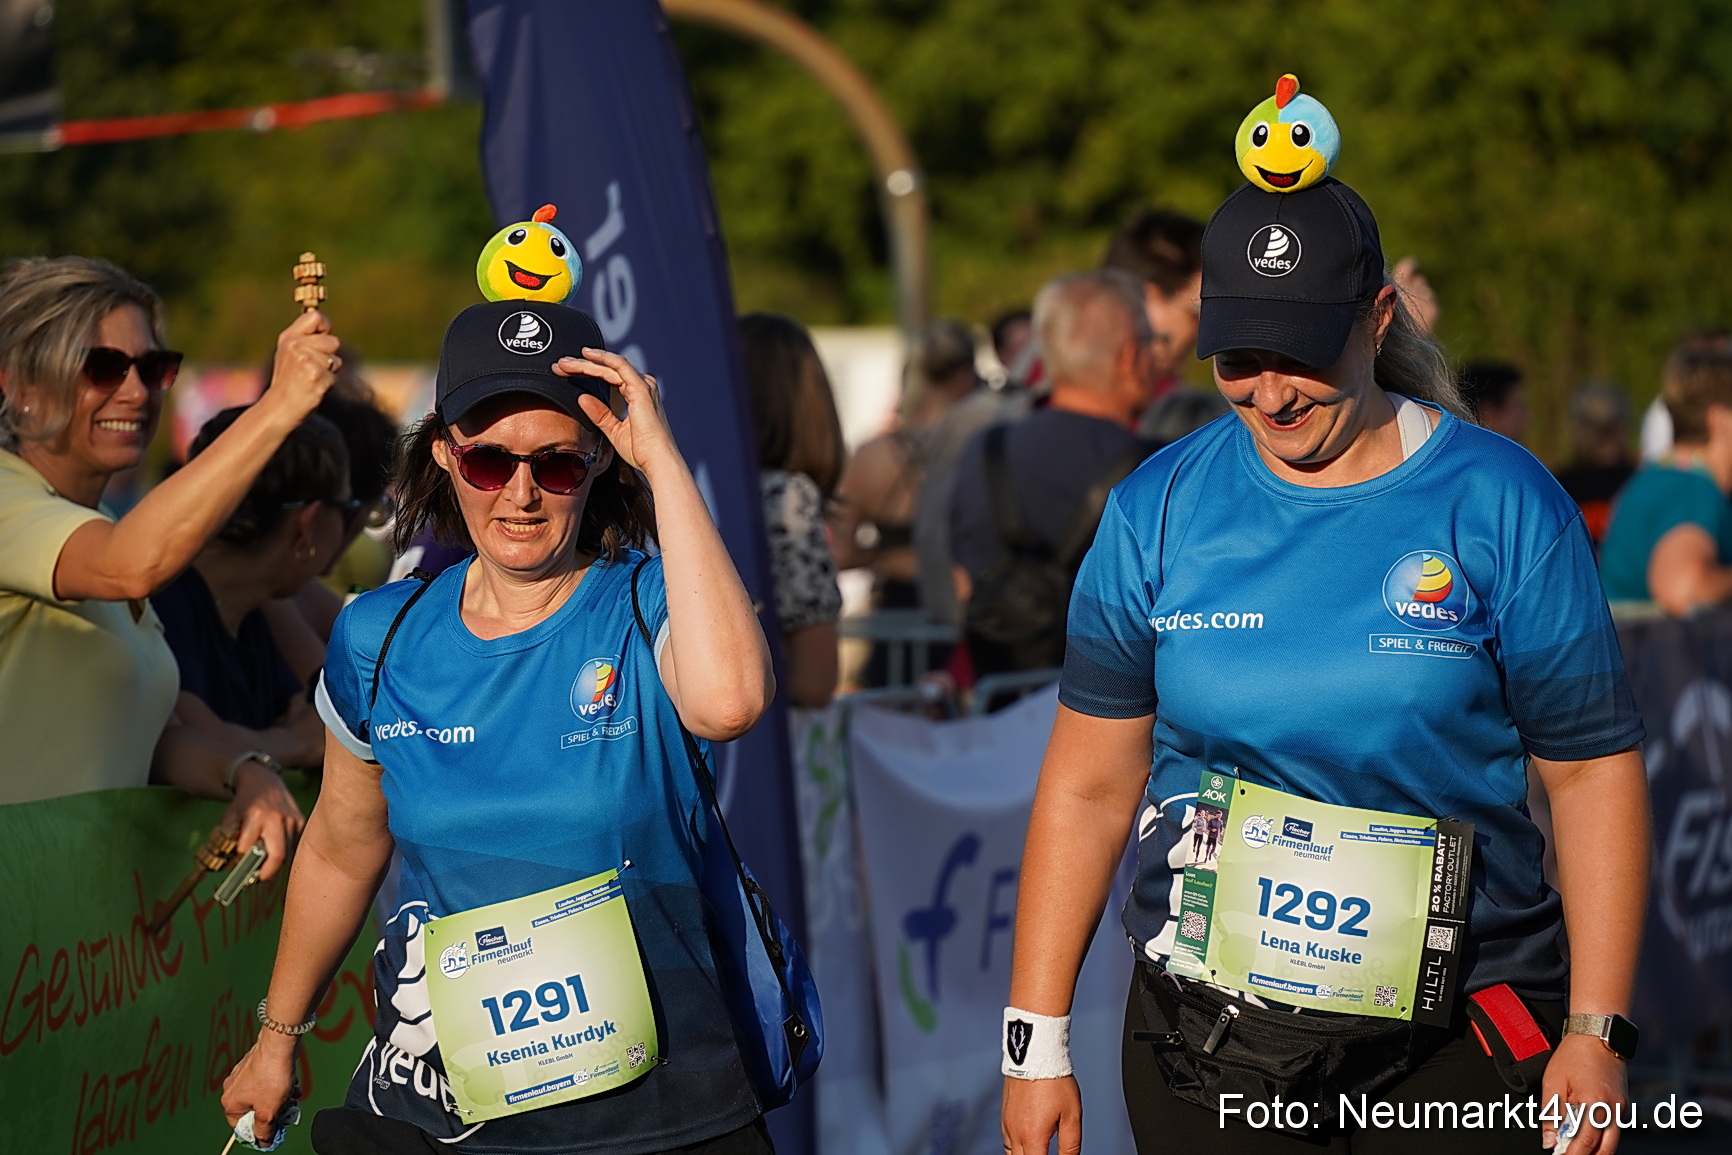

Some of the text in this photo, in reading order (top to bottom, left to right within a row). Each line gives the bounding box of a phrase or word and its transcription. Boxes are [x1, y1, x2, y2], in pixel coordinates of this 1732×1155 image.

[1254, 256, 1291, 270] vedes
[506, 338, 544, 350] vedes
[1395, 601, 1458, 622] vedes
[1379, 638, 1471, 653] SPIEL & FREIZEIT
[374, 717, 475, 744] vedes.com
[567, 720, 631, 744] SPIEL & FREIZEIT
[1202, 789, 1227, 803] AOK
[1272, 835, 1334, 855] Firmenlauf
[1293, 850, 1331, 862] neumarkt
[1185, 871, 1196, 879] Lust
[1431, 833, 1446, 912] 20 % RABATT
[1443, 835, 1457, 913] FACTORY OUTLET
[1257, 876, 1372, 938] 1292
[471, 937, 532, 965] Firmenlauf
[497, 948, 534, 965] neumarkt
[1260, 930, 1362, 966] Lena Kuske
[1290, 958, 1326, 971] KLEBL GmbH
[1251, 975, 1313, 994] firmenlauf.bayern
[1421, 956, 1442, 1011] HILTL
[482, 974, 590, 1036] 1291
[486, 1020, 617, 1067] Ksenia Kurdyk
[538, 1053, 574, 1066] KLEBL GmbH
[589, 1064, 619, 1079] Firmenlauf
[509, 1079, 572, 1102] firmenlauf.bayern
